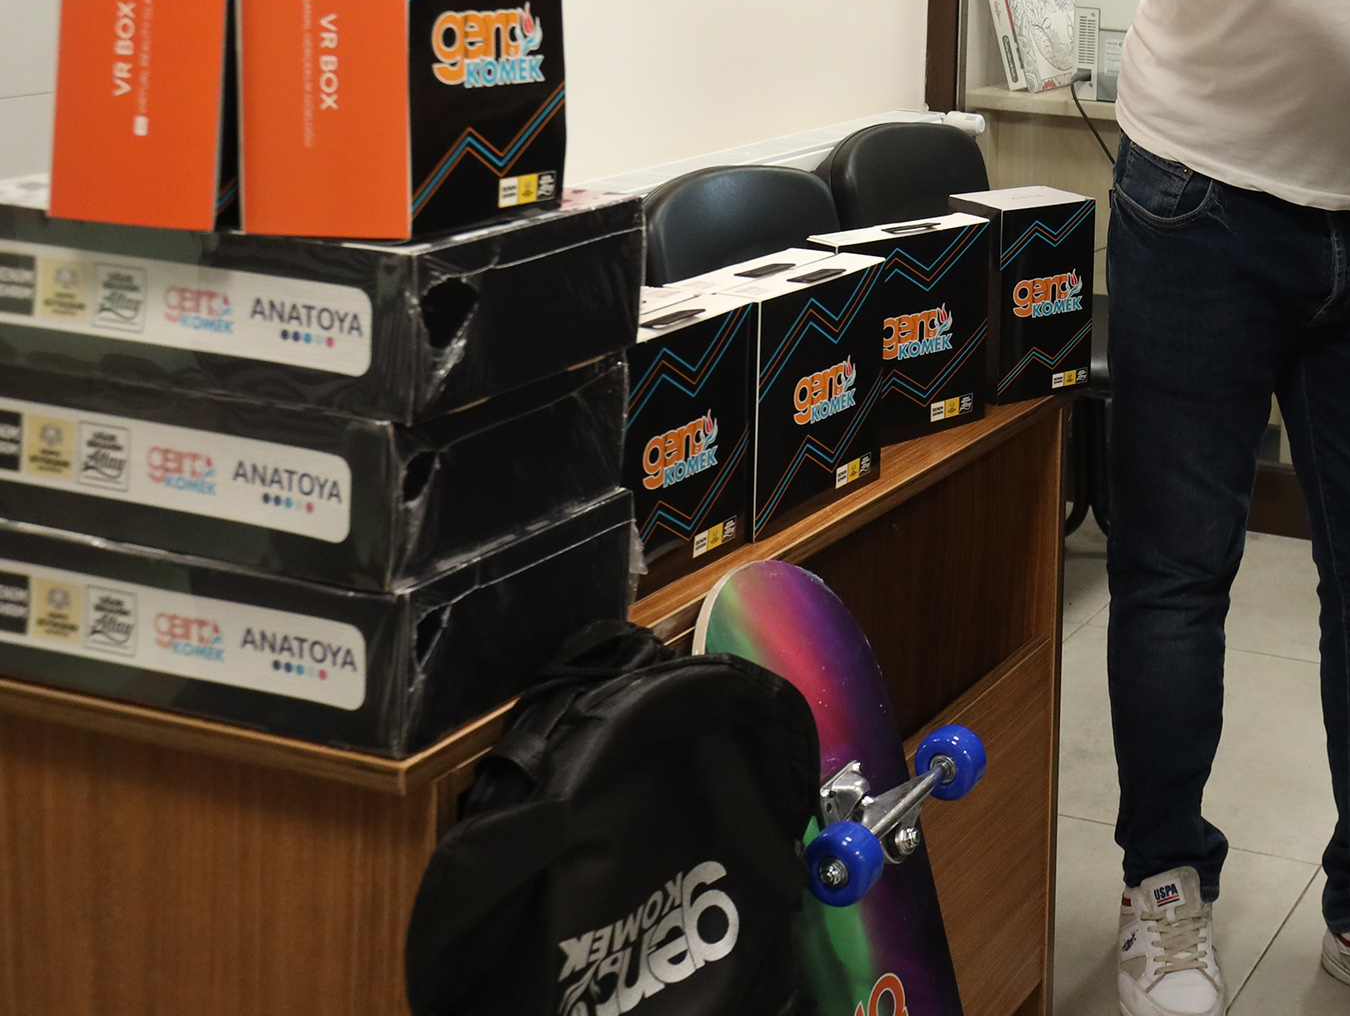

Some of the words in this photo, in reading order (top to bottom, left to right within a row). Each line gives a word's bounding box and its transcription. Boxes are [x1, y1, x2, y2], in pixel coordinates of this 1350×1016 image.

[113, 1, 136, 56] BOX
[319, 12, 338, 49] VR
[112, 61, 133, 96] VR
[319, 54, 339, 110] BOX
[464, 55, 545, 88] KOMEK
[250, 297, 364, 337] ANATOYA
[1032, 296, 1083, 318] KOMEK
[897, 333, 953, 360] KOMEK
[810, 388, 857, 424] KOMEK
[232, 460, 343, 504] ANATOYA
[663, 445, 719, 488] KOMEK
[241, 628, 357, 672] ANATOYA
[1154, 883, 1179, 901] USPA
[558, 871, 683, 982] KOMEK
